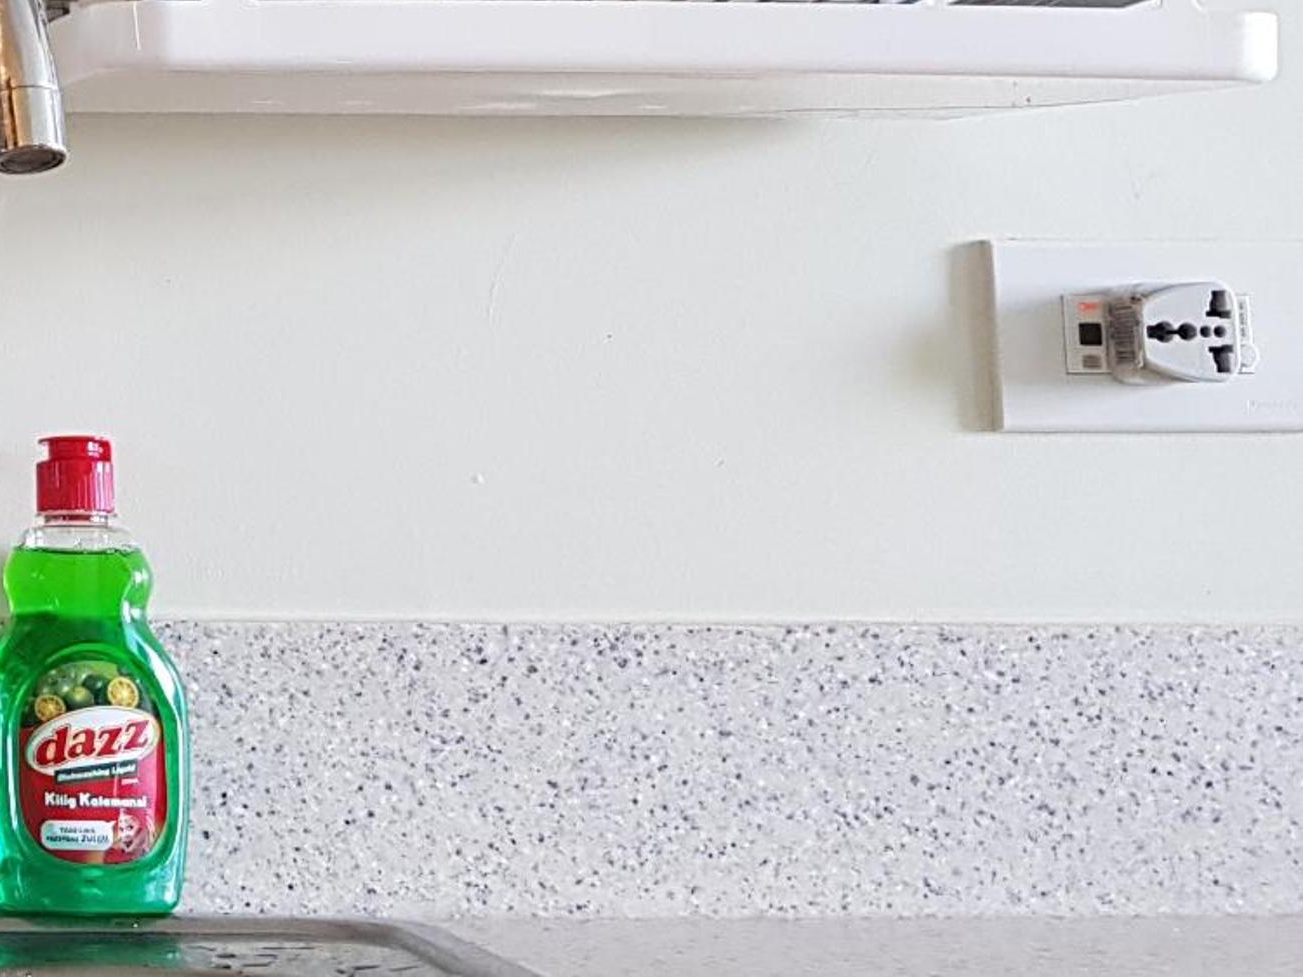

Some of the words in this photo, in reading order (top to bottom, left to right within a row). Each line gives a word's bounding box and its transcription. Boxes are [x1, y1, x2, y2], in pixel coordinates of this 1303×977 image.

[34, 719, 150, 766] dazz
[44, 792, 76, 809] Kilig
[79, 792, 147, 808] Kalamansi
